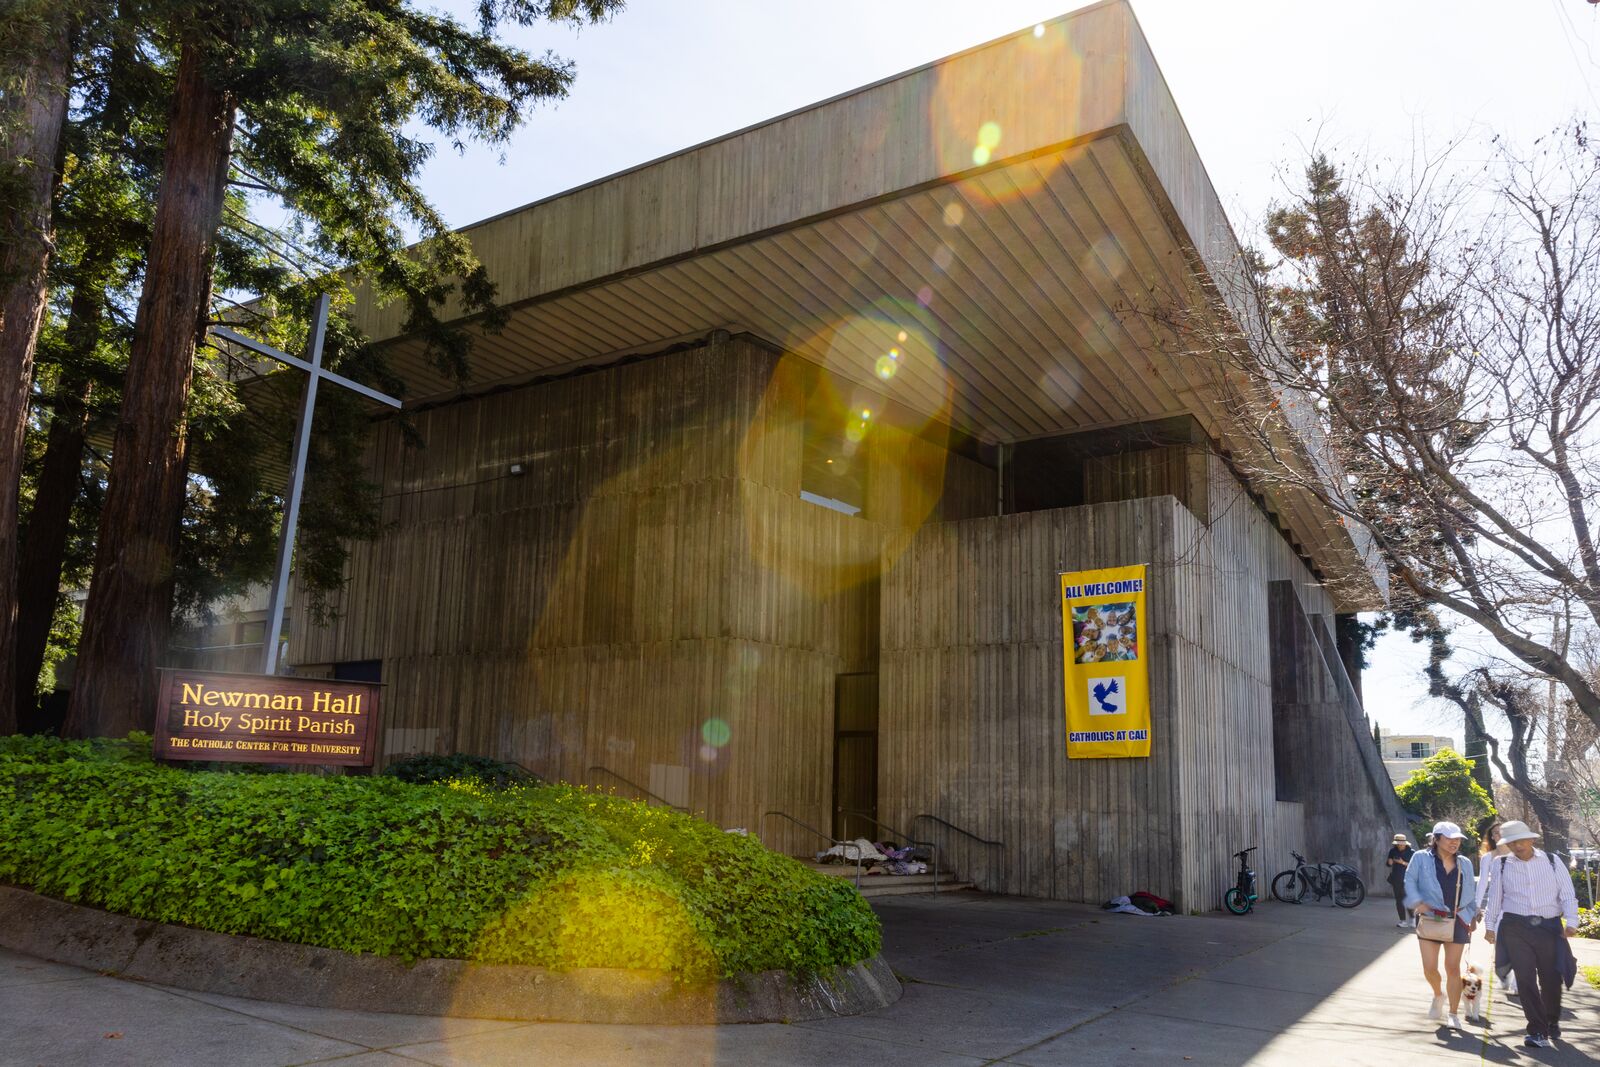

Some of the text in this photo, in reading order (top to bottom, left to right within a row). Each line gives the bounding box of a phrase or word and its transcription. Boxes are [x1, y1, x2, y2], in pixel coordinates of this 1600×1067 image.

[1066, 579, 1142, 598] ALL WELCOME!
[180, 683, 361, 714] Newman Hall
[183, 710, 355, 735] Holy Spirit Parish
[170, 737, 360, 754] THE CATHOLIC CENTER FOR THE UNIVERSITY
[1069, 730, 1147, 742] CATHOLICS AT CAL!
